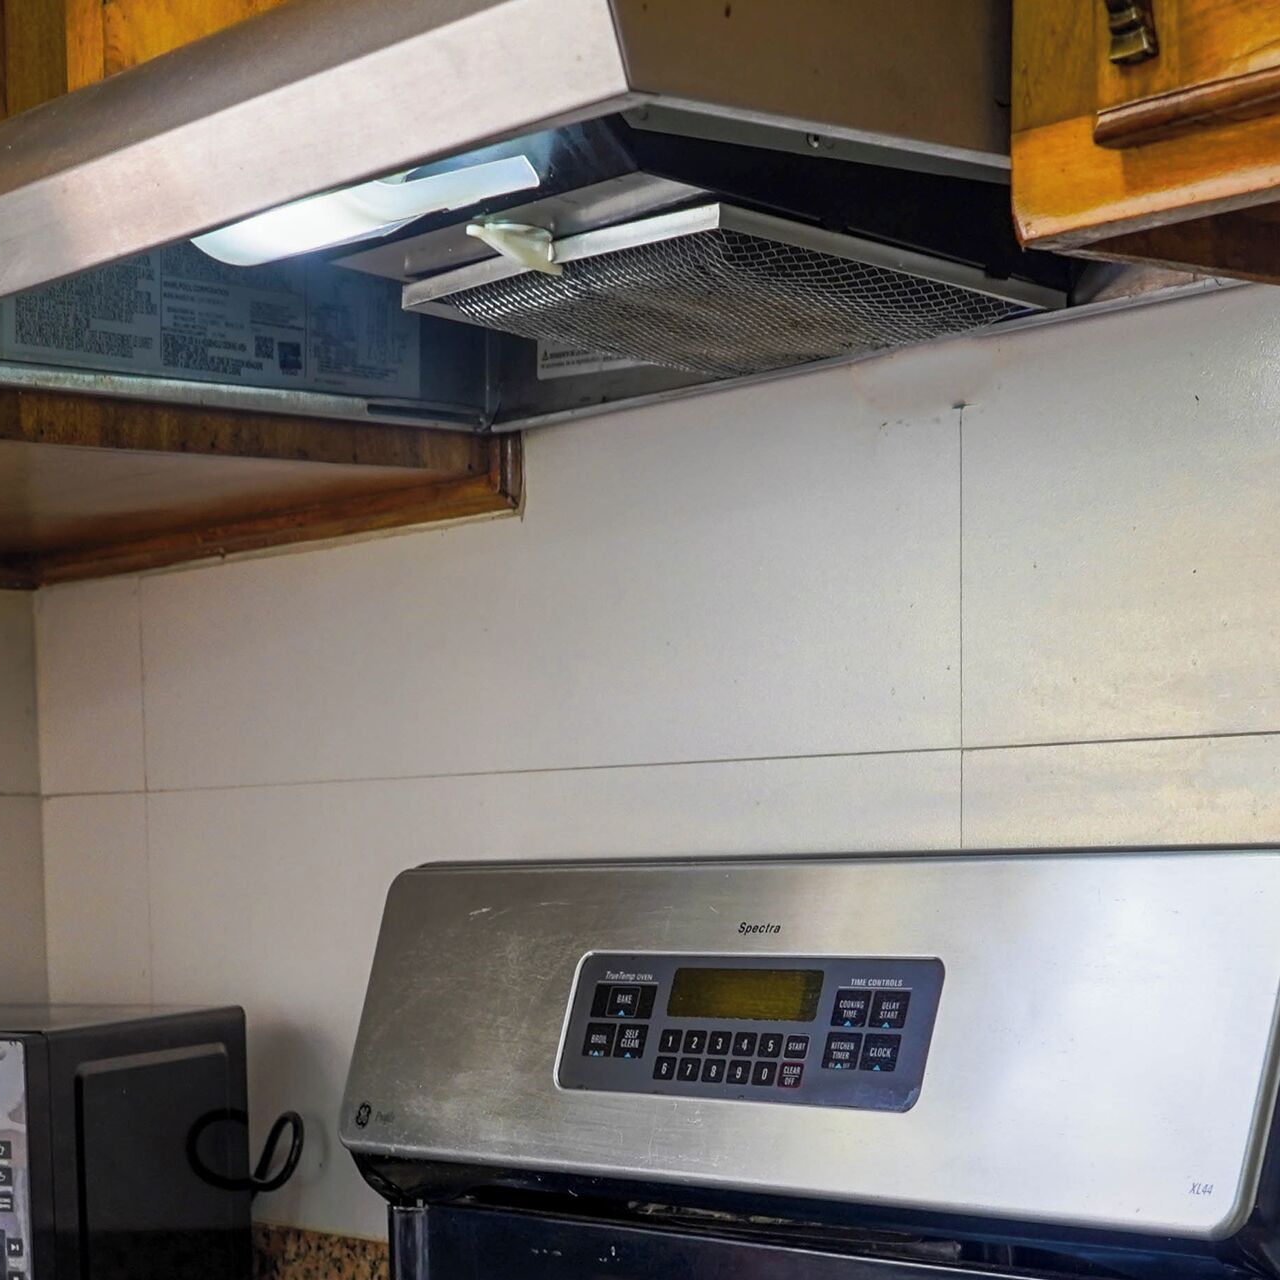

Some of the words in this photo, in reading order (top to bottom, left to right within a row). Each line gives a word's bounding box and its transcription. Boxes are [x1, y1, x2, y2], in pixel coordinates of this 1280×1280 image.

[738, 921, 781, 936] Spectra
[605, 971, 635, 981] TrueTemp
[867, 979, 903, 987] CONTROLS
[616, 994, 632, 1004] BAKE
[839, 1000, 864, 1009] COOKING
[882, 1002, 900, 1010] DELAY
[843, 1010, 857, 1019] TIME
[879, 1011, 898, 1019] START
[625, 1029, 639, 1038] SELF
[590, 1034, 607, 1044] BROIL
[620, 1039, 640, 1048] CLEAN
[691, 1036, 698, 1049] 2
[716, 1037, 723, 1050] 3
[741, 1038, 748, 1051] 4
[767, 1039, 774, 1052] 5
[788, 1042, 806, 1050] START
[830, 1042, 855, 1050] KITCHEN
[832, 1051, 850, 1060] TIMER
[869, 1047, 892, 1058] CLOCK
[661, 1062, 668, 1075] 6
[685, 1063, 693, 1076] 7
[710, 1065, 717, 1077] 8
[735, 1066, 742, 1079] 9
[761, 1067, 768, 1080] 0
[783, 1066, 801, 1075] CLEAR
[784, 1077, 796, 1086] OFF
[1189, 1182, 1214, 1196] XL44
